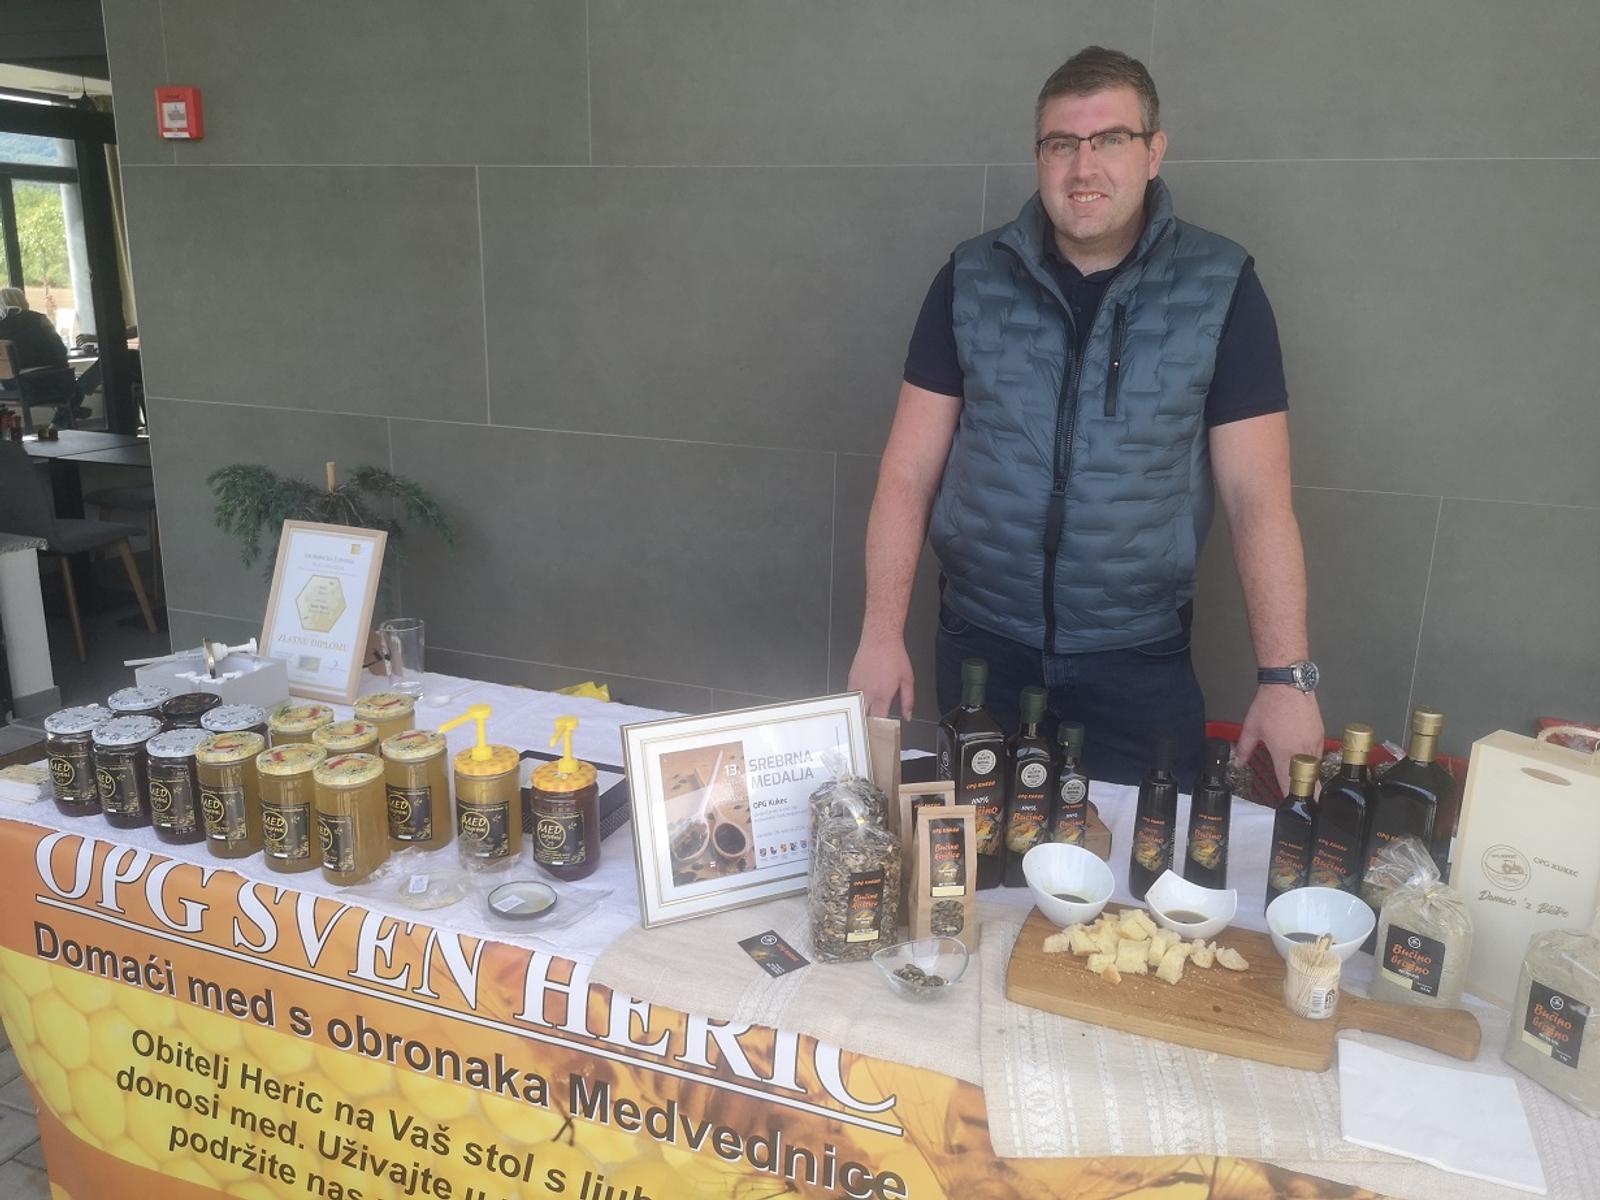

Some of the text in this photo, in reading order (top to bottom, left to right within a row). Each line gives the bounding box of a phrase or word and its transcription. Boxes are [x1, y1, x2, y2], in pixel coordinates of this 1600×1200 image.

[749, 750, 813, 772] SREBRNA
[752, 767, 814, 789] MEDALJA
[753, 801, 767, 809] OPG
[34, 830, 209, 933] OPG
[233, 879, 488, 1010] SVEN
[34, 921, 909, 1200] Domaći med s obronaka Medvednice
[132, 1029, 230, 1090] Obitelj
[240, 1063, 324, 1114] Heric
[335, 1101, 375, 1131] na
[388, 1109, 452, 1156] Vaš
[463, 1142, 534, 1183] stol
[544, 1168, 567, 1194] s
[116, 1066, 220, 1120] donosi
[230, 1105, 304, 1149] med.
[318, 1129, 453, 1200] Uživajte
[169, 1125, 364, 1200] podržite nas
